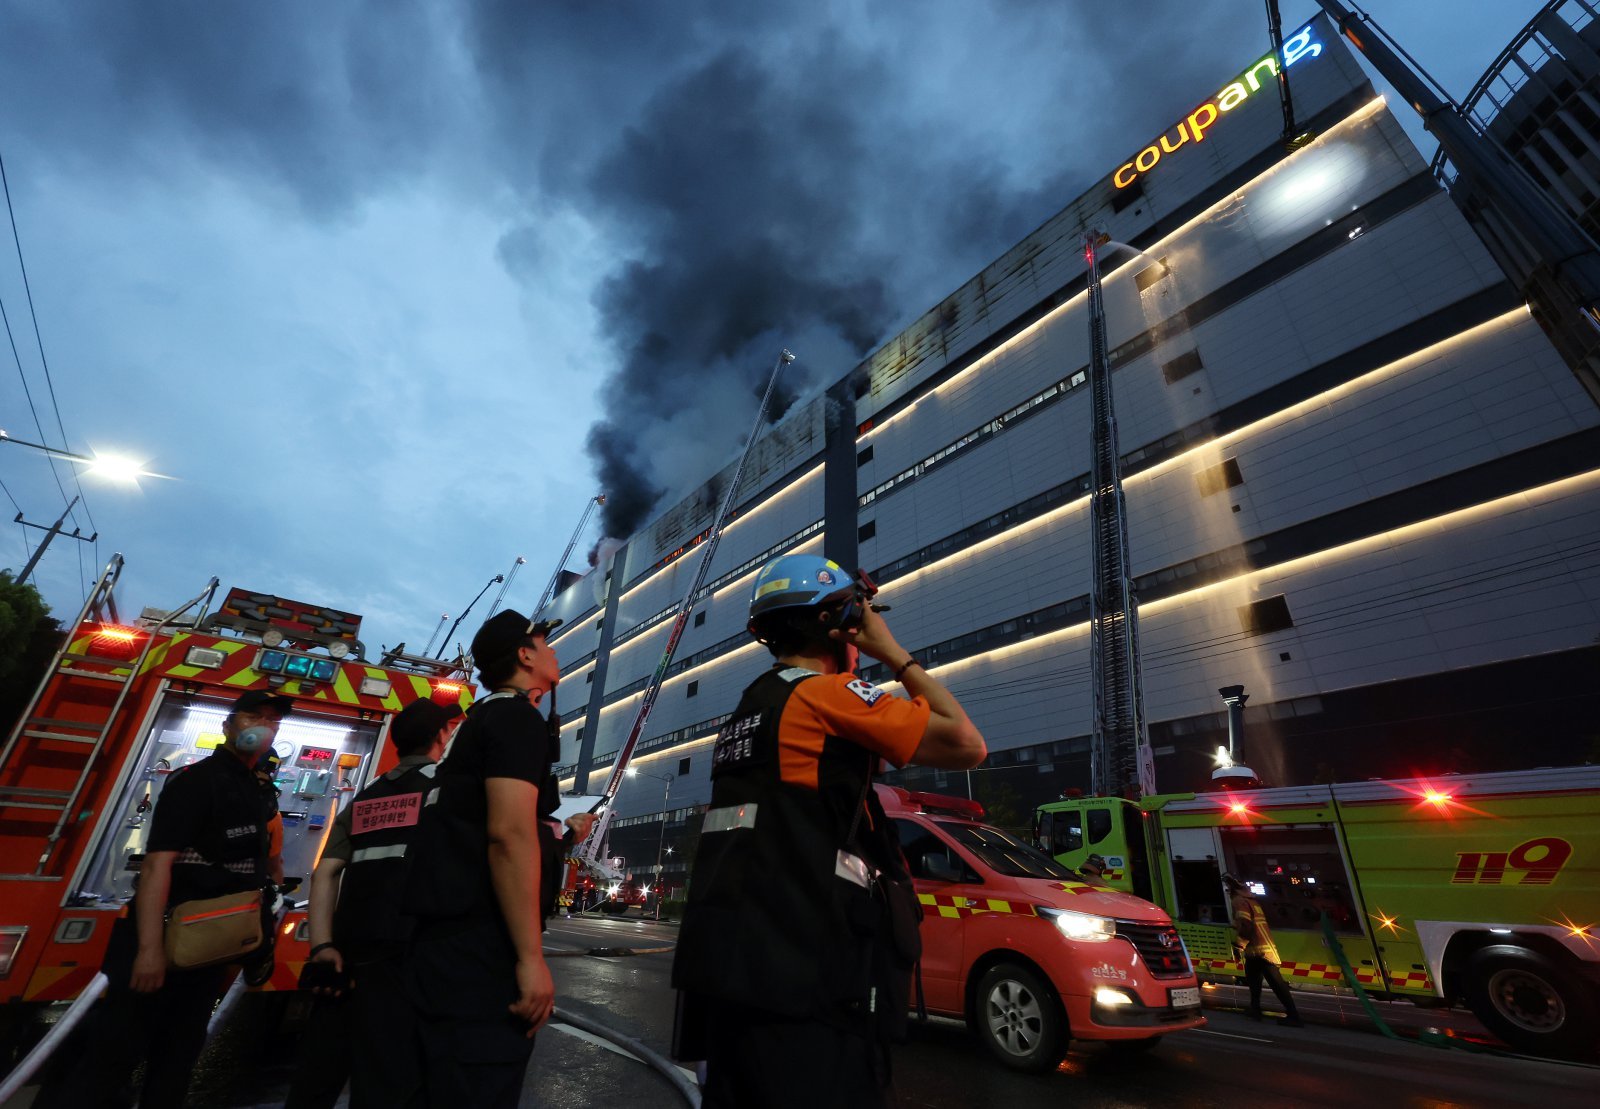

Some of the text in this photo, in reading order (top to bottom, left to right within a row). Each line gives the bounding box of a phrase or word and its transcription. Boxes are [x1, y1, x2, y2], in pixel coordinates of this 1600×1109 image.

[1113, 25, 1322, 189] coupang
[307, 749, 331, 759] 3794
[356, 796, 418, 817] 긴급구조지휘대
[362, 811, 407, 829] 현장지휘반
[1451, 837, 1572, 884] 119
[1091, 966, 1127, 980] 인천소방
